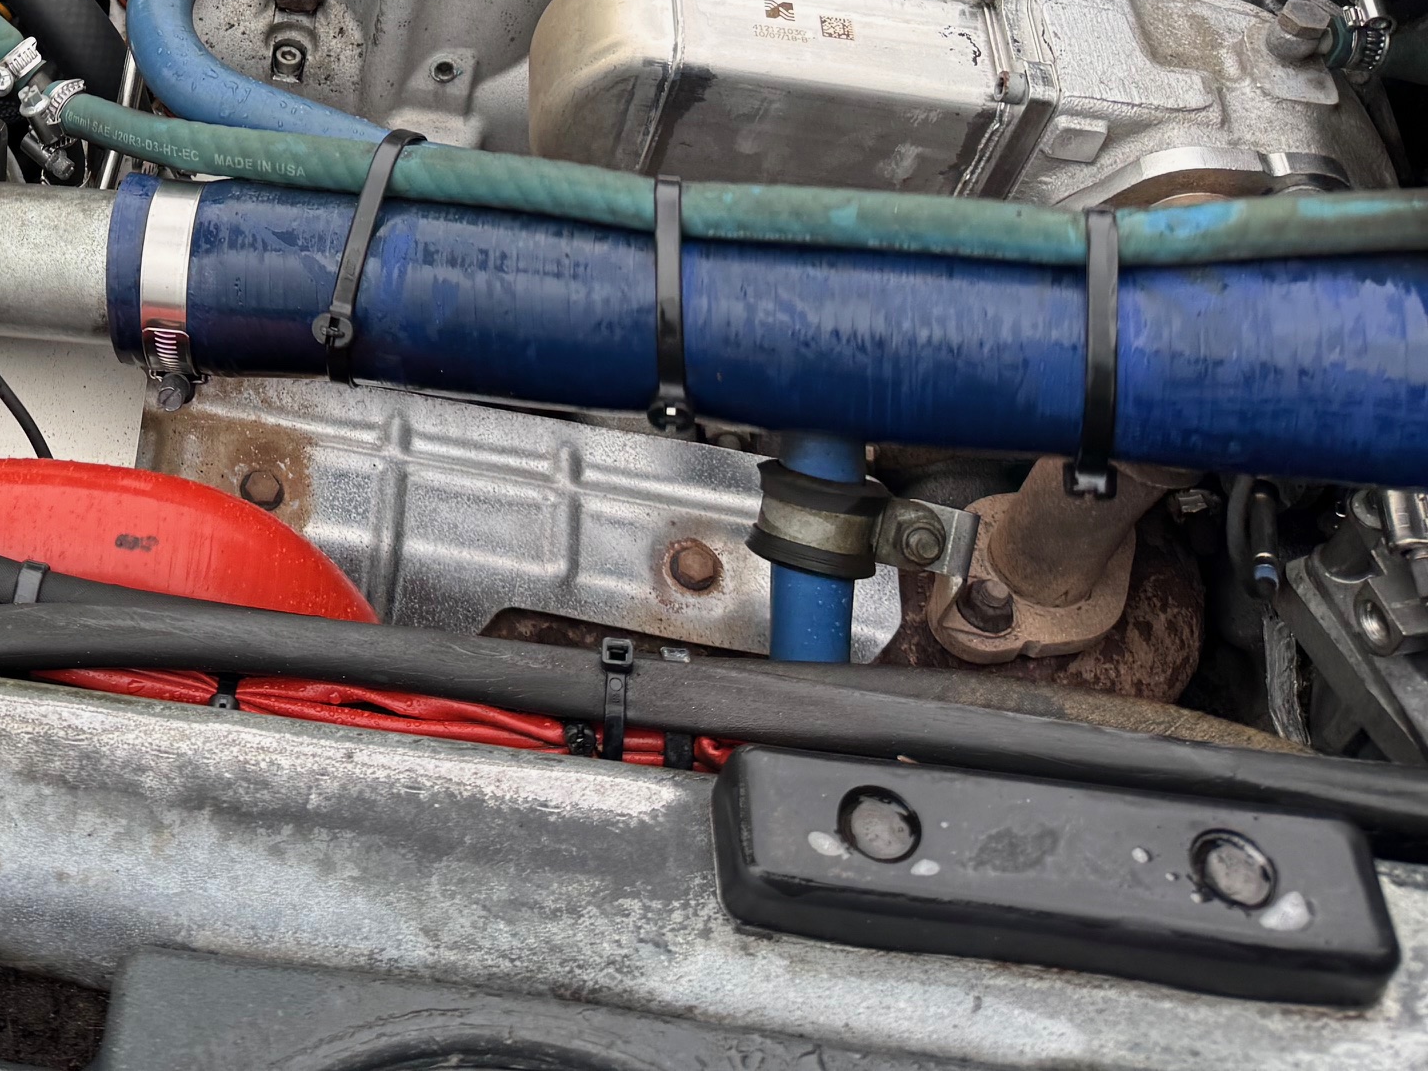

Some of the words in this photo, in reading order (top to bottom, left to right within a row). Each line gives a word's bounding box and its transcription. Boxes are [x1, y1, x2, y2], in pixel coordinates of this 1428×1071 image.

[92, 121, 110, 138] SAE
[214, 154, 253, 170] MADE
[257, 160, 271, 173] IN
[276, 163, 306, 177] USA
